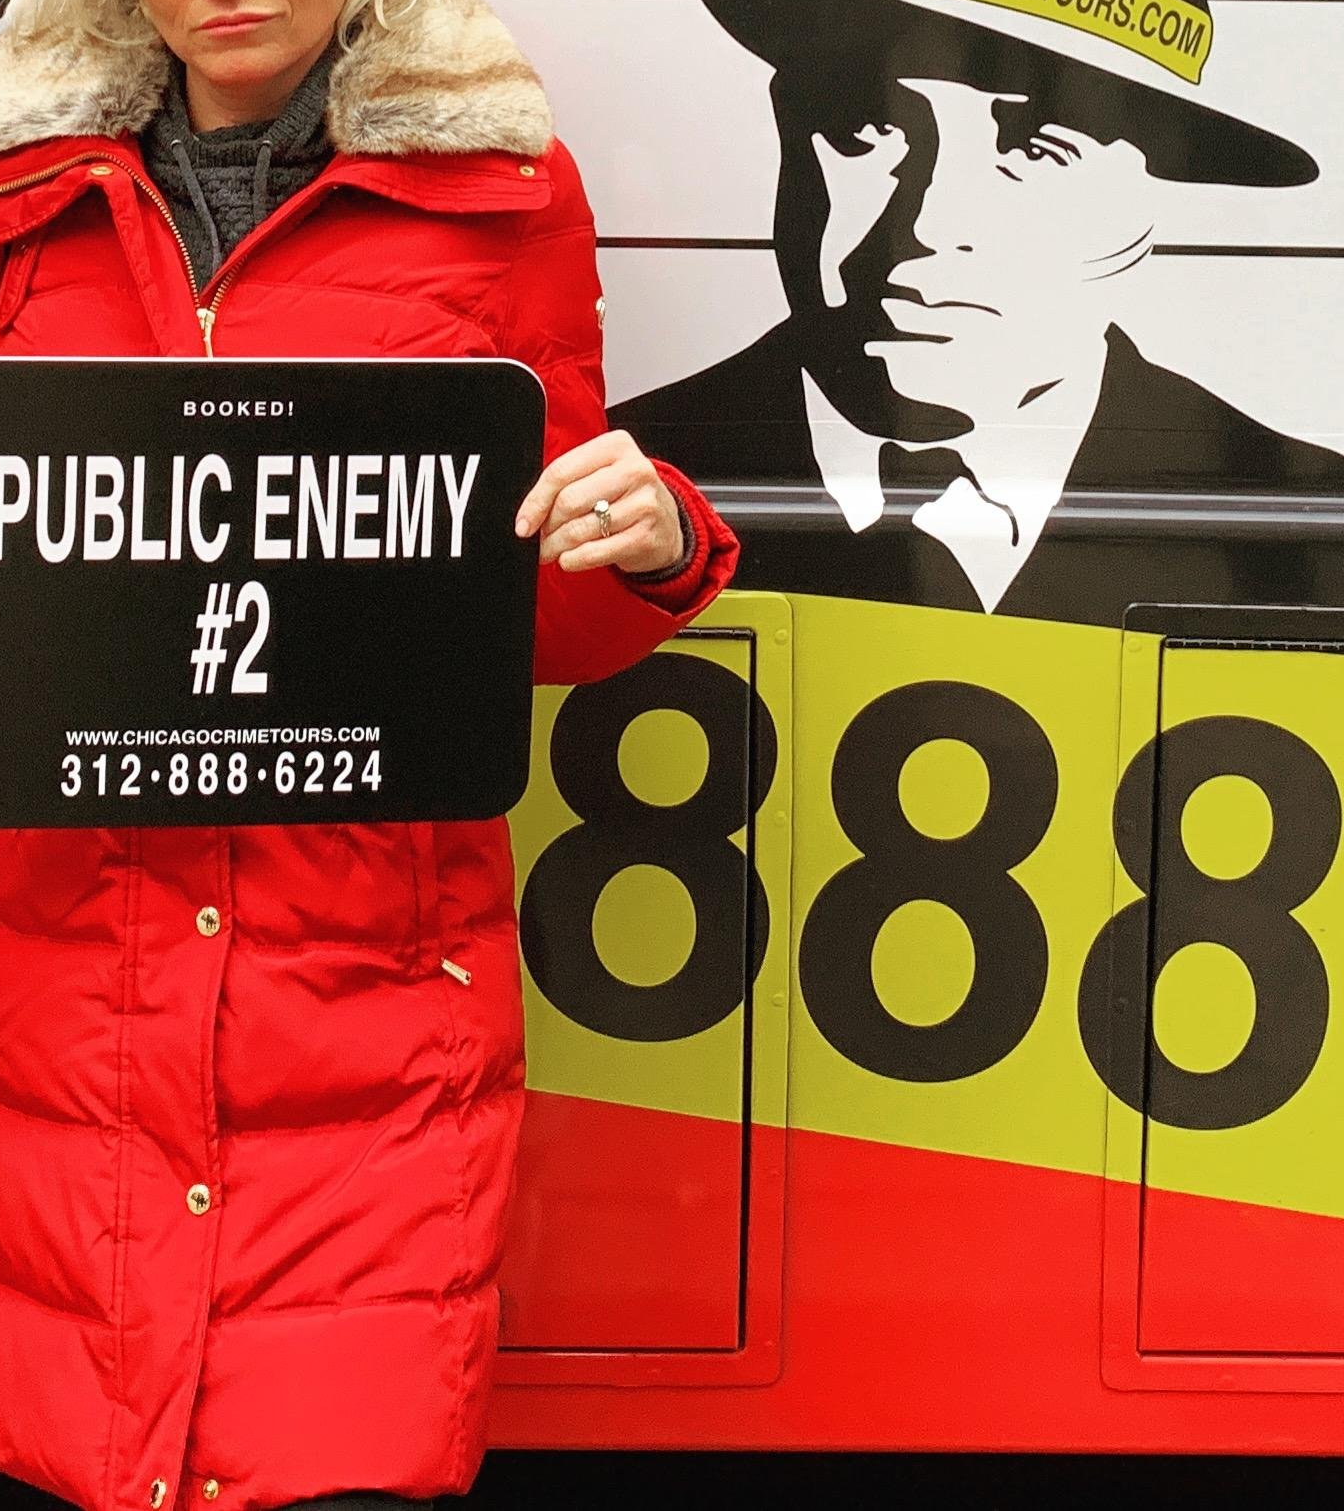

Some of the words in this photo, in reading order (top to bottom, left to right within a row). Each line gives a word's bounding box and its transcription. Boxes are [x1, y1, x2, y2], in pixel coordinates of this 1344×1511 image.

[182, 400, 296, 417] BOOKED!
[253, 454, 481, 560] ENEMY
[190, 580, 271, 694] #2
[65, 726, 381, 747] WWW.CHICAGOCRIMETOURS.COM
